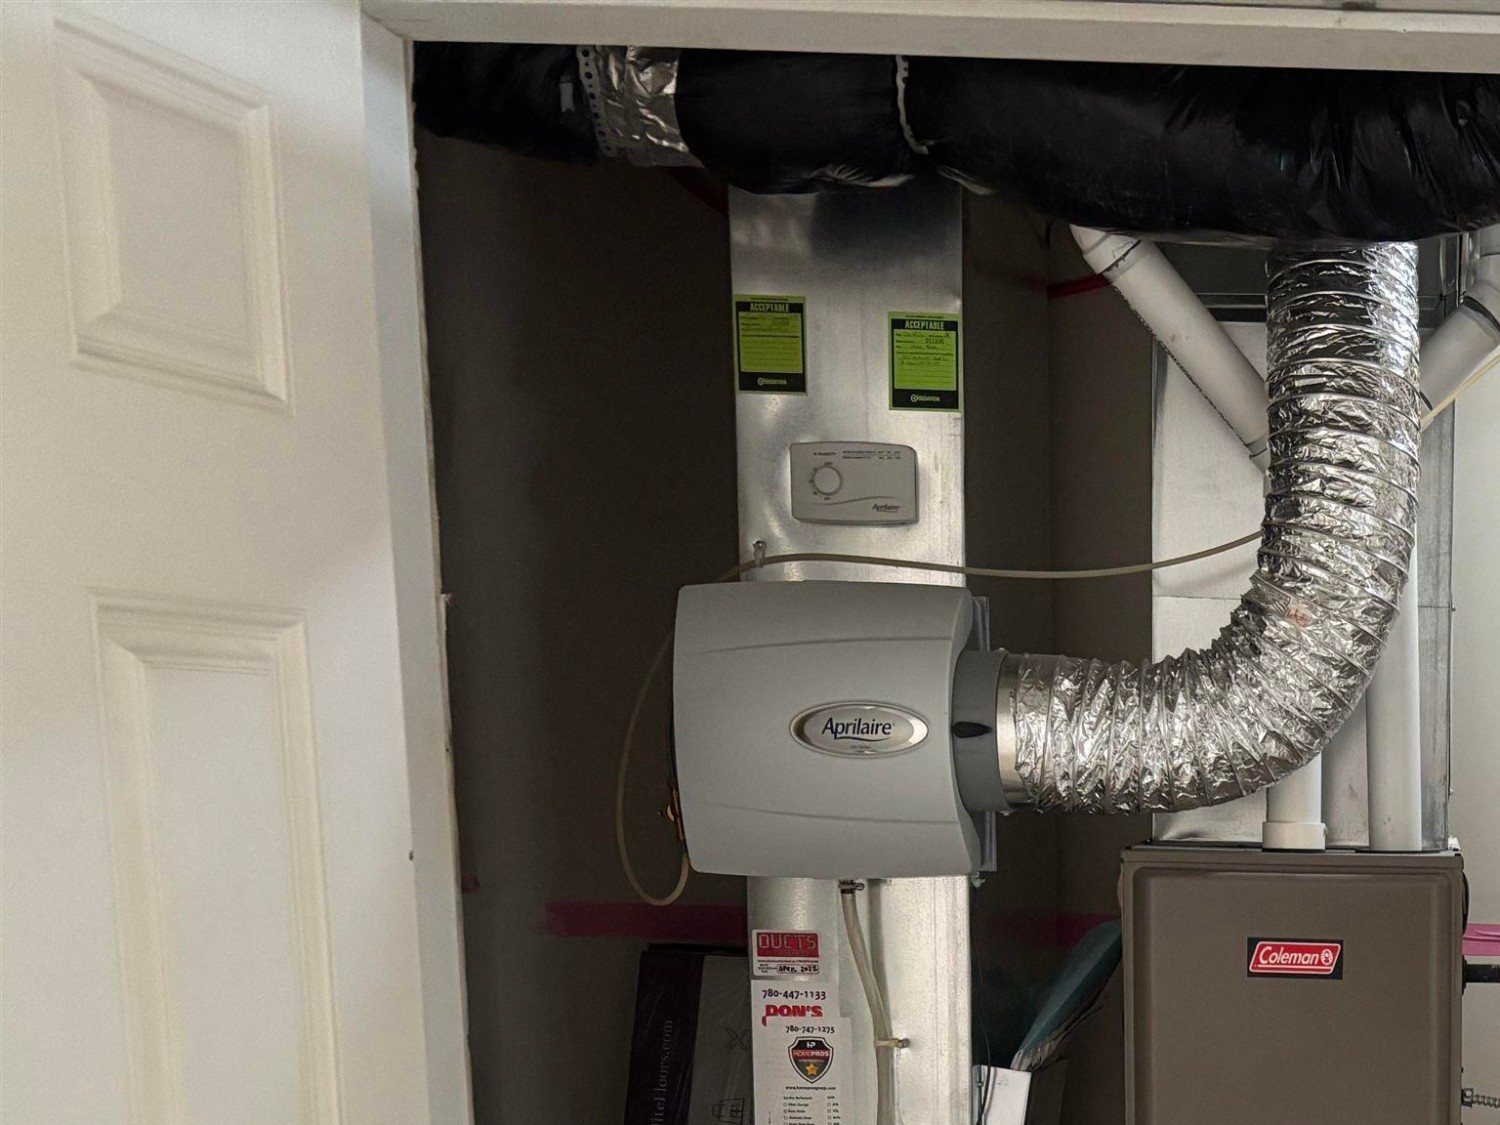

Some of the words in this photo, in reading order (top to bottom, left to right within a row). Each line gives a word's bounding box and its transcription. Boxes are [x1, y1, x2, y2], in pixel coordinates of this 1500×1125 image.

[750, 303, 790, 313] ACCEPTABLE
[904, 320, 945, 330] ACCEPTABLE
[822, 717, 892, 740] Aprilaire
[758, 934, 817, 949] DUCTS
[1259, 946, 1319, 965] Coleman
[762, 989, 827, 1000] 780-447-1133
[765, 1004, 823, 1018] DON'S
[786, 1025, 835, 1034] 780-747-1275
